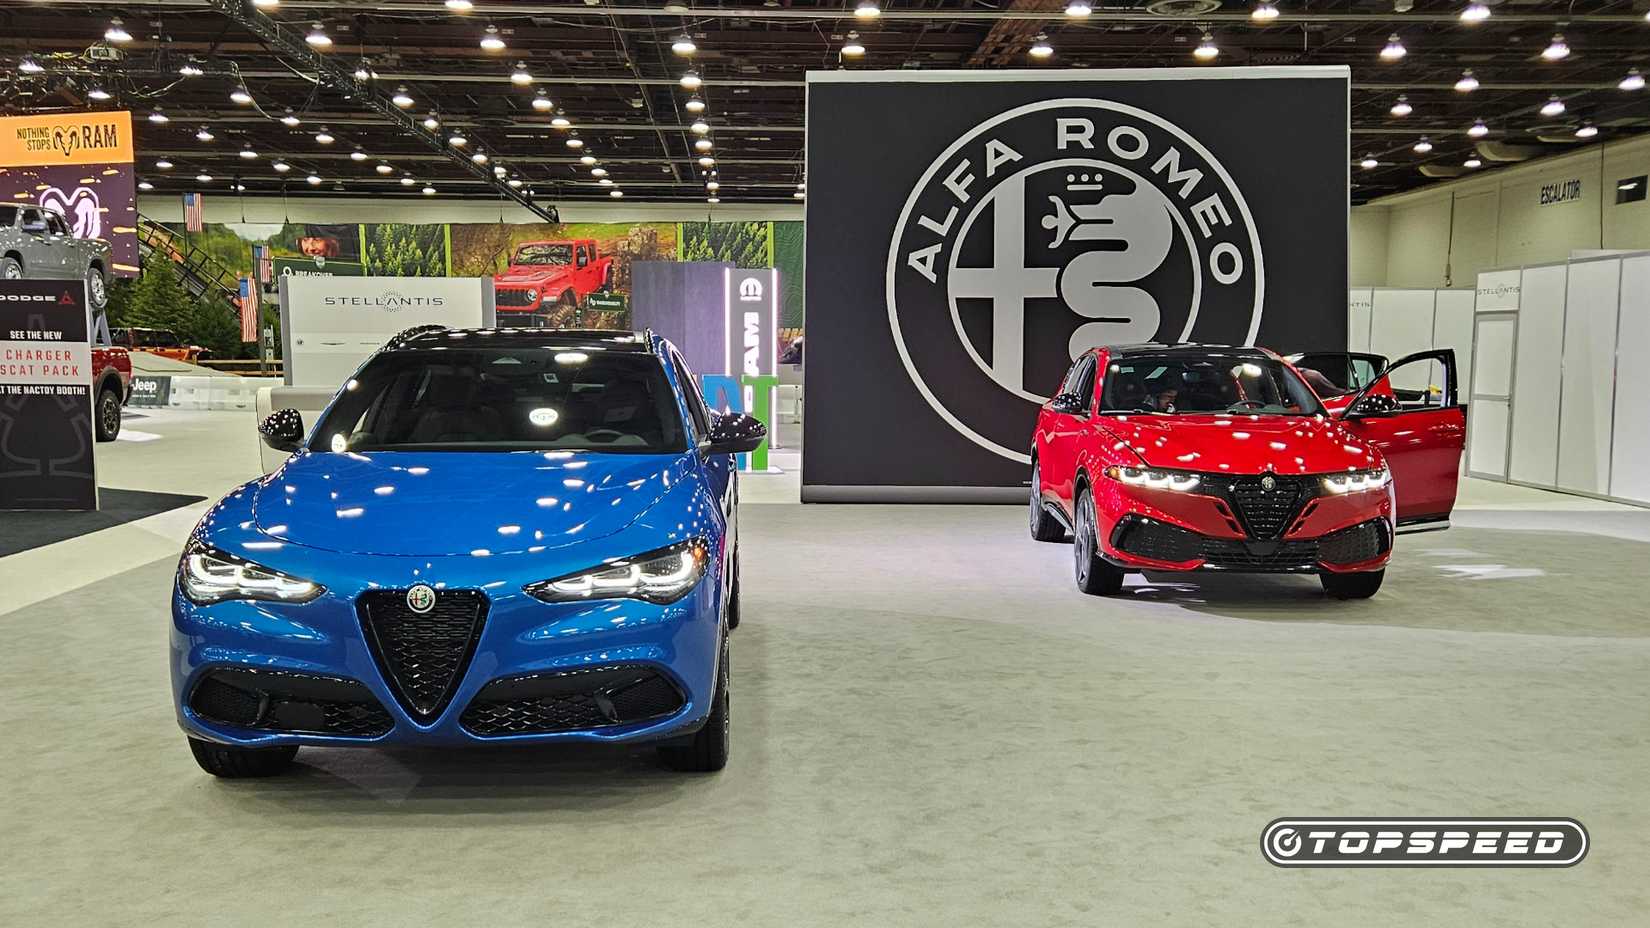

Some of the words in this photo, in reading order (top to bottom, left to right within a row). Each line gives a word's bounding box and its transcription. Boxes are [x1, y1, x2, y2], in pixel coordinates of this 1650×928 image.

[16, 127, 50, 139] NOTHING
[82, 124, 117, 148] RAM
[27, 139, 51, 151] STOPS
[1540, 179, 1580, 205] ESCALATOR
[907, 138, 1024, 284] ALFA
[1056, 118, 1244, 285] ROMEO
[324, 297, 443, 306] STELLANTIS
[10, 331, 25, 340] SEE
[27, 331, 42, 340] THE
[44, 331, 62, 340] NEW
[6, 350, 72, 361] CHARGER
[0, 364, 34, 375] SCAT
[43, 365, 79, 376] PACK
[8, 386, 22, 394] THE
[23, 386, 55, 395] NACTOY
[57, 386, 86, 395] BOOTH!
[131, 378, 157, 393] Jeep
